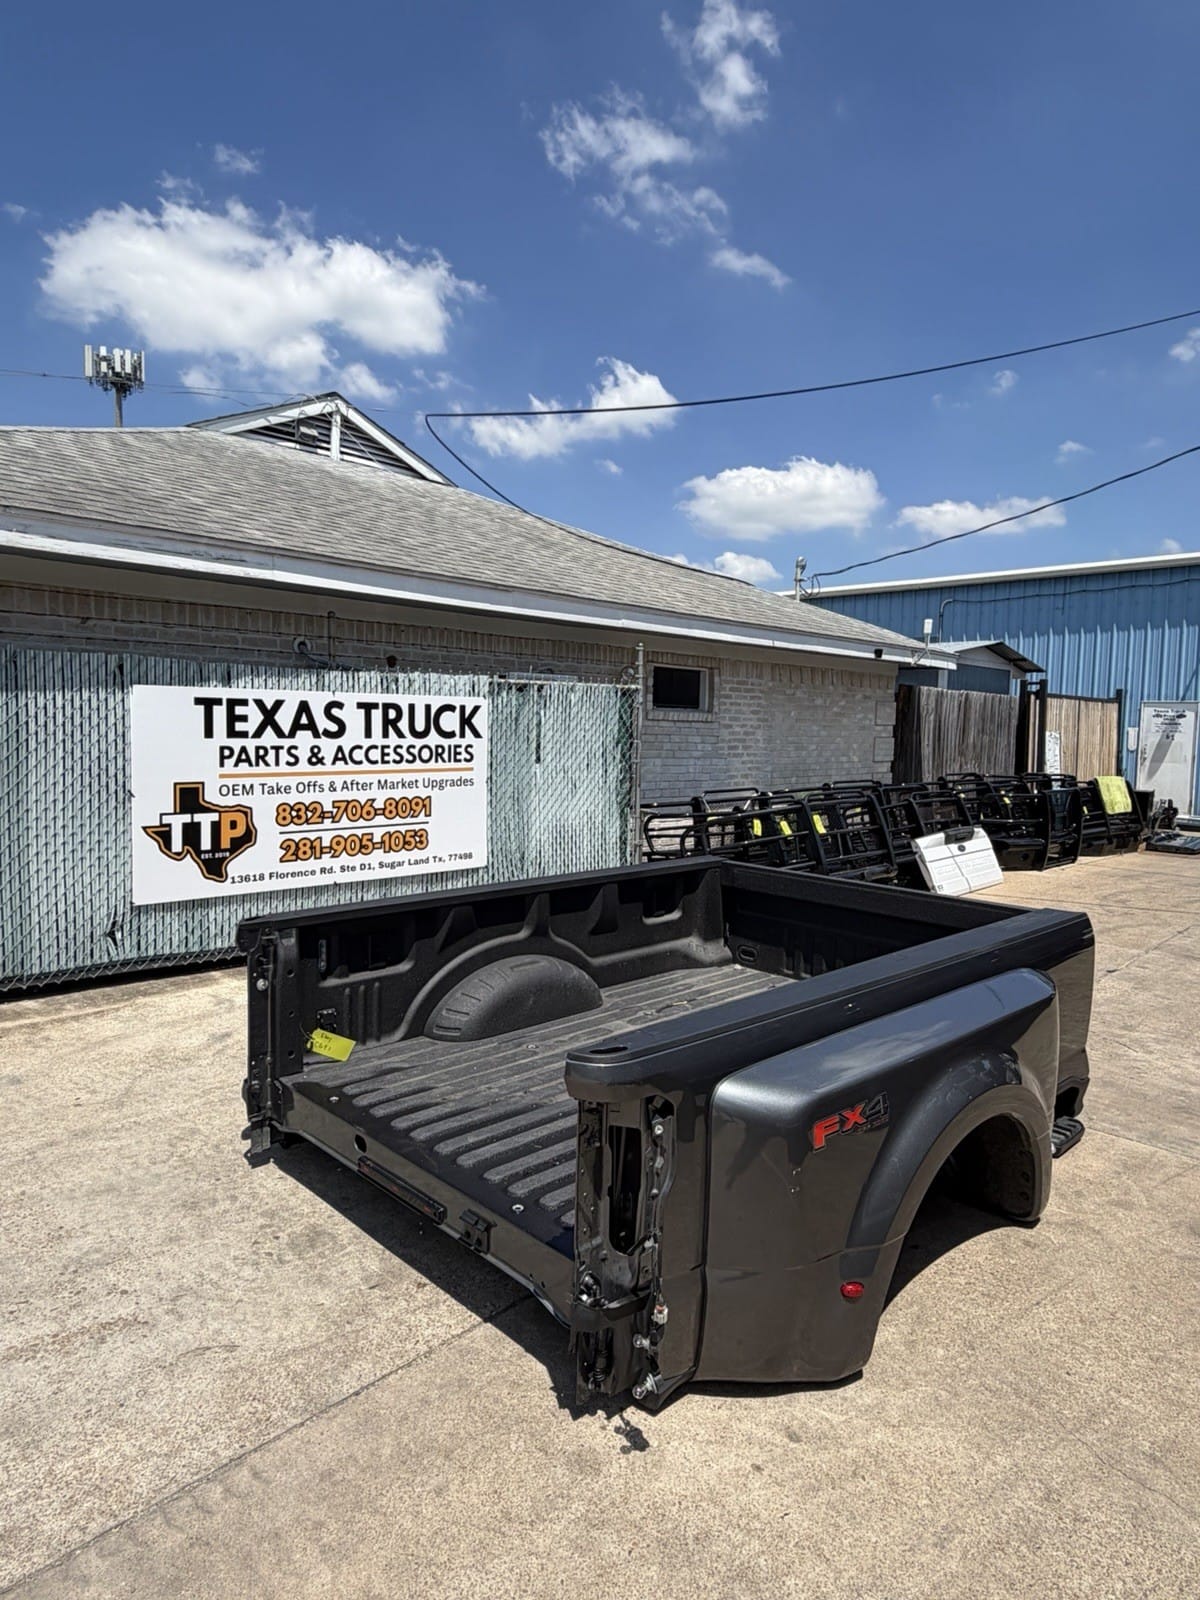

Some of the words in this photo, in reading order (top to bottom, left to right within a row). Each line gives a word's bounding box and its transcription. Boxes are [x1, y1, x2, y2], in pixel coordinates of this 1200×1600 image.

[194, 697, 347, 739] TEXAS
[356, 701, 483, 740] TRUCK
[218, 745, 300, 768] PARTS
[308, 745, 326, 766] &
[331, 743, 474, 766] ACCESSORIES
[218, 783, 255, 797] OEM
[259, 782, 292, 796] Take
[295, 780, 325, 794] Offs
[328, 780, 338, 793] &
[340, 778, 374, 793] After
[377, 777, 420, 791] Market
[422, 776, 474, 793] Upgrades
[275, 796, 432, 827] 832-706-8091
[160, 810, 247, 854] TTP
[279, 828, 430, 864] 281-905-1053
[230, 873, 266, 884] 13618
[269, 868, 317, 880] Florence
[319, 866, 337, 876] Rd.
[340, 864, 357, 873] Ste
[378, 859, 406, 870] Sugar
[408, 856, 430, 866] Land
[432, 855, 446, 865] Tx,
[447, 852, 473, 862] 77498
[811, 1092, 890, 1153] FX4
